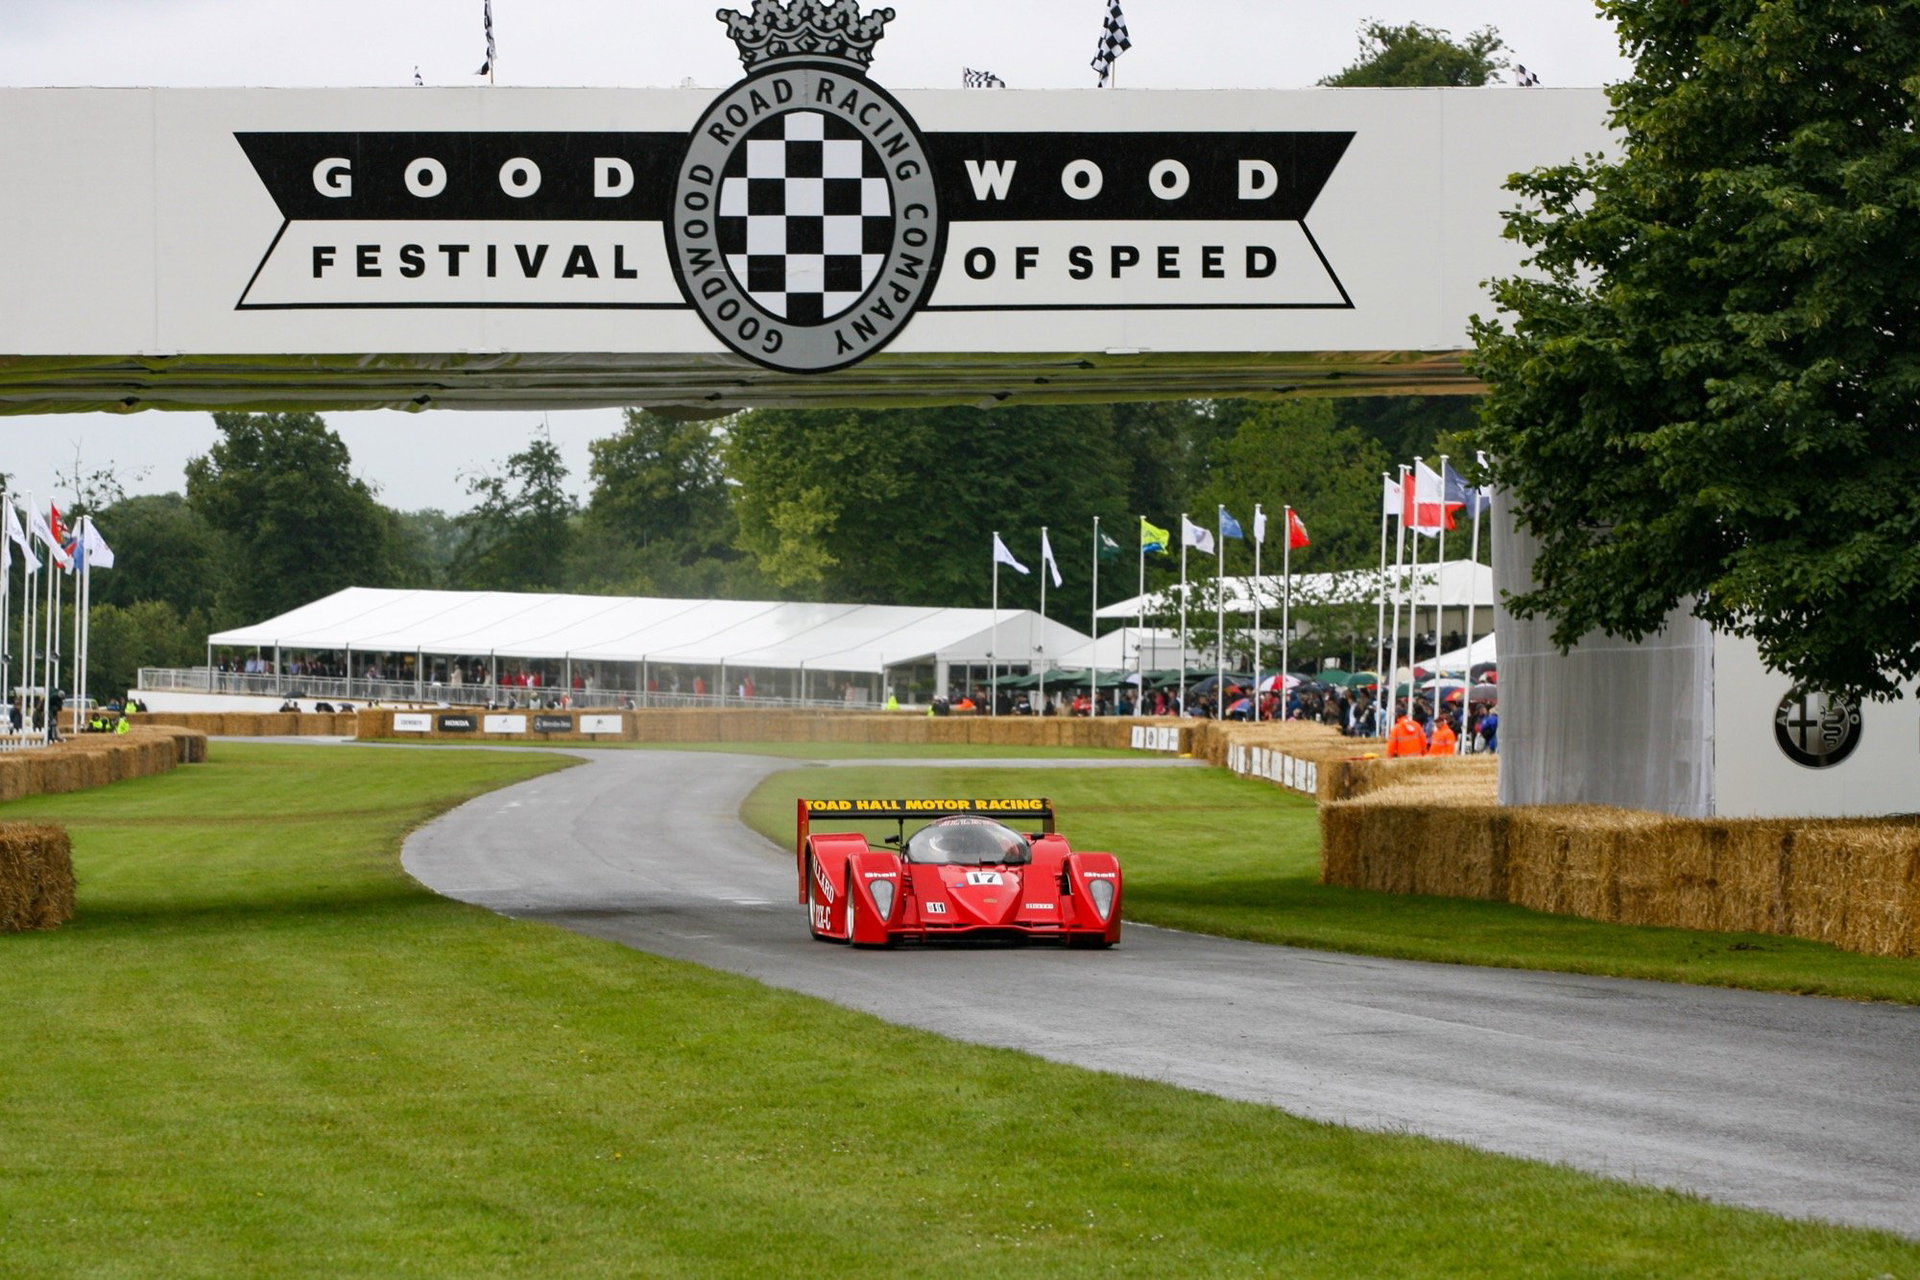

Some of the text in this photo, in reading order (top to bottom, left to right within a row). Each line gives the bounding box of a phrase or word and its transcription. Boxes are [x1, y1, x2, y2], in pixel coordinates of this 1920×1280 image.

[312, 157, 1278, 200] GOOD WOOD
[684, 77, 928, 355] GOODWOOD ROAD RACING COMPANY
[312, 244, 1277, 280] FESTIVAL OF SPEED
[445, 719, 470, 727] HONDA
[805, 799, 1043, 811] TOAD HALL MOTOR RACING
[972, 873, 997, 883] 17
